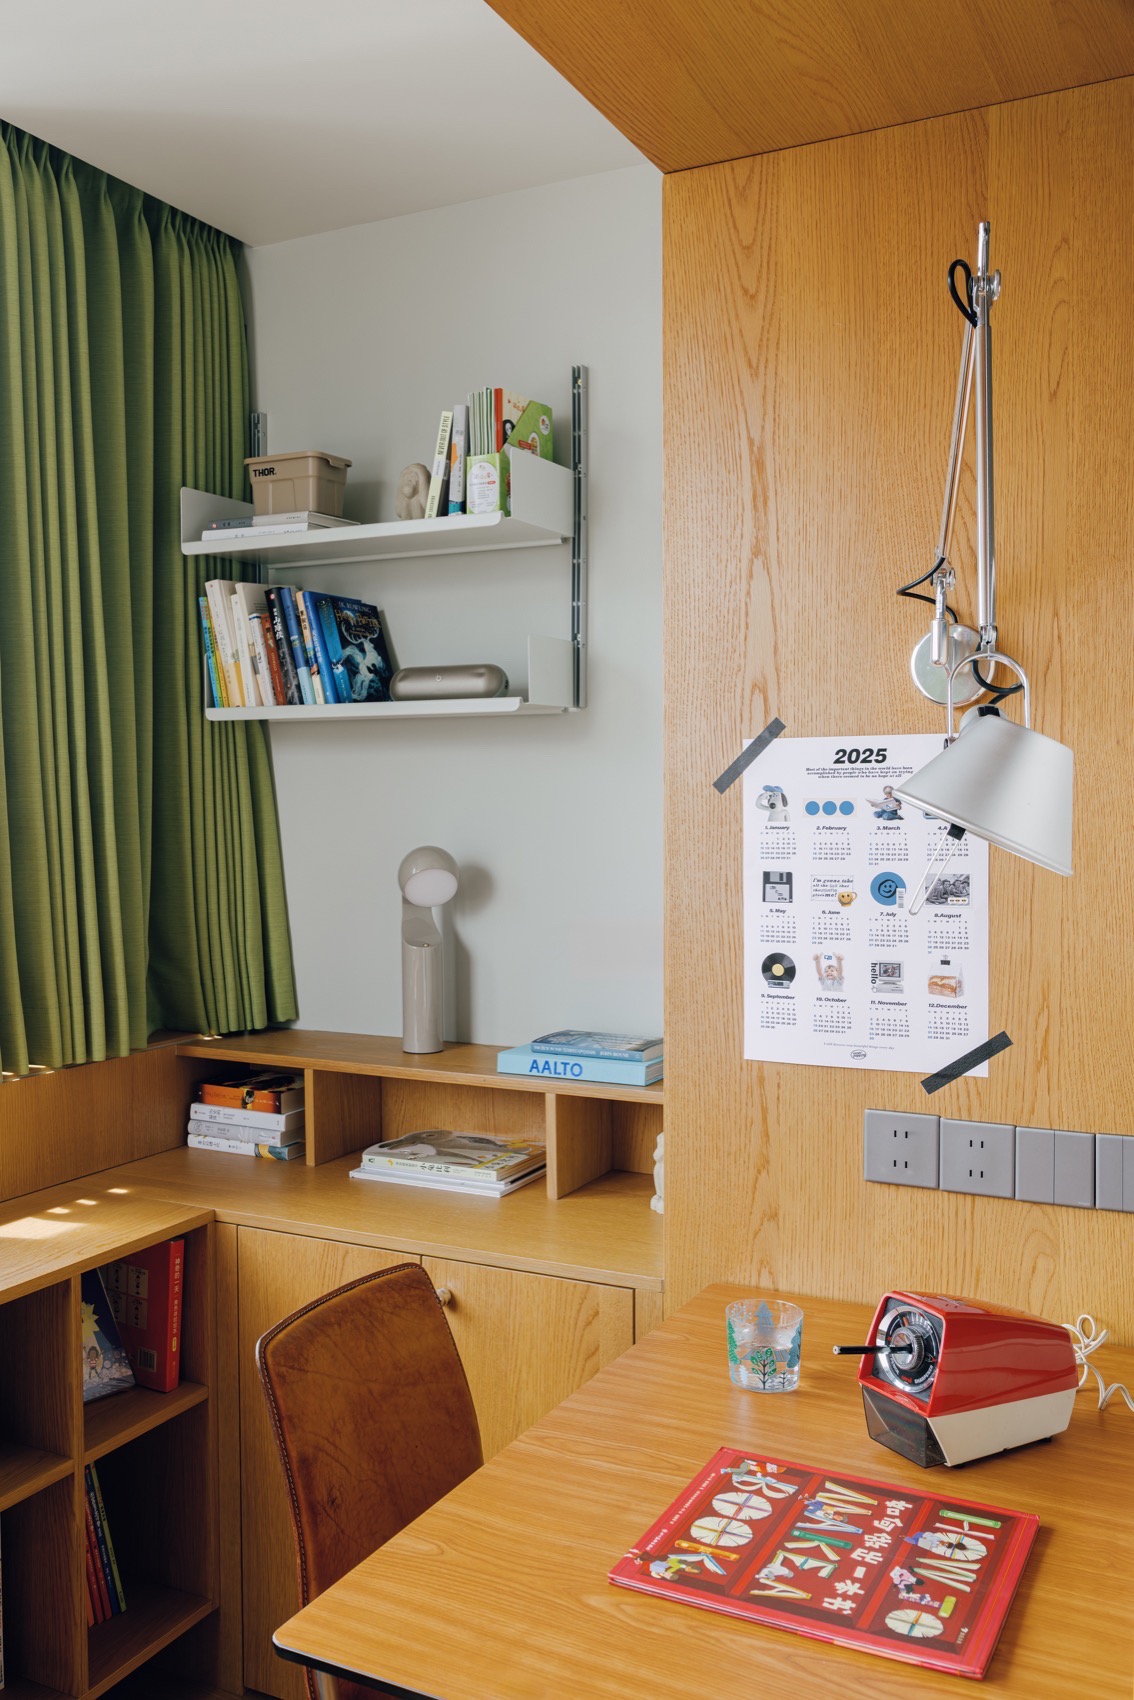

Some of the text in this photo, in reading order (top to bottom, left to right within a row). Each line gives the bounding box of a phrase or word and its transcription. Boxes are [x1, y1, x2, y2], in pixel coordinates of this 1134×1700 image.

[442, 415, 450, 428] STYLE
[439, 434, 447, 443] OUT
[437, 442, 446, 456] NEVER
[832, 748, 888, 765] 2025
[870, 962, 878, 984] hello
[529, 1059, 583, 1077] AALTO
[667, 1472, 799, 1575] BOOK
[748, 1480, 879, 1600] MAKE A
[823, 1499, 913, 1615] 如何做出一本书
[916, 1509, 1002, 1593] HOW
